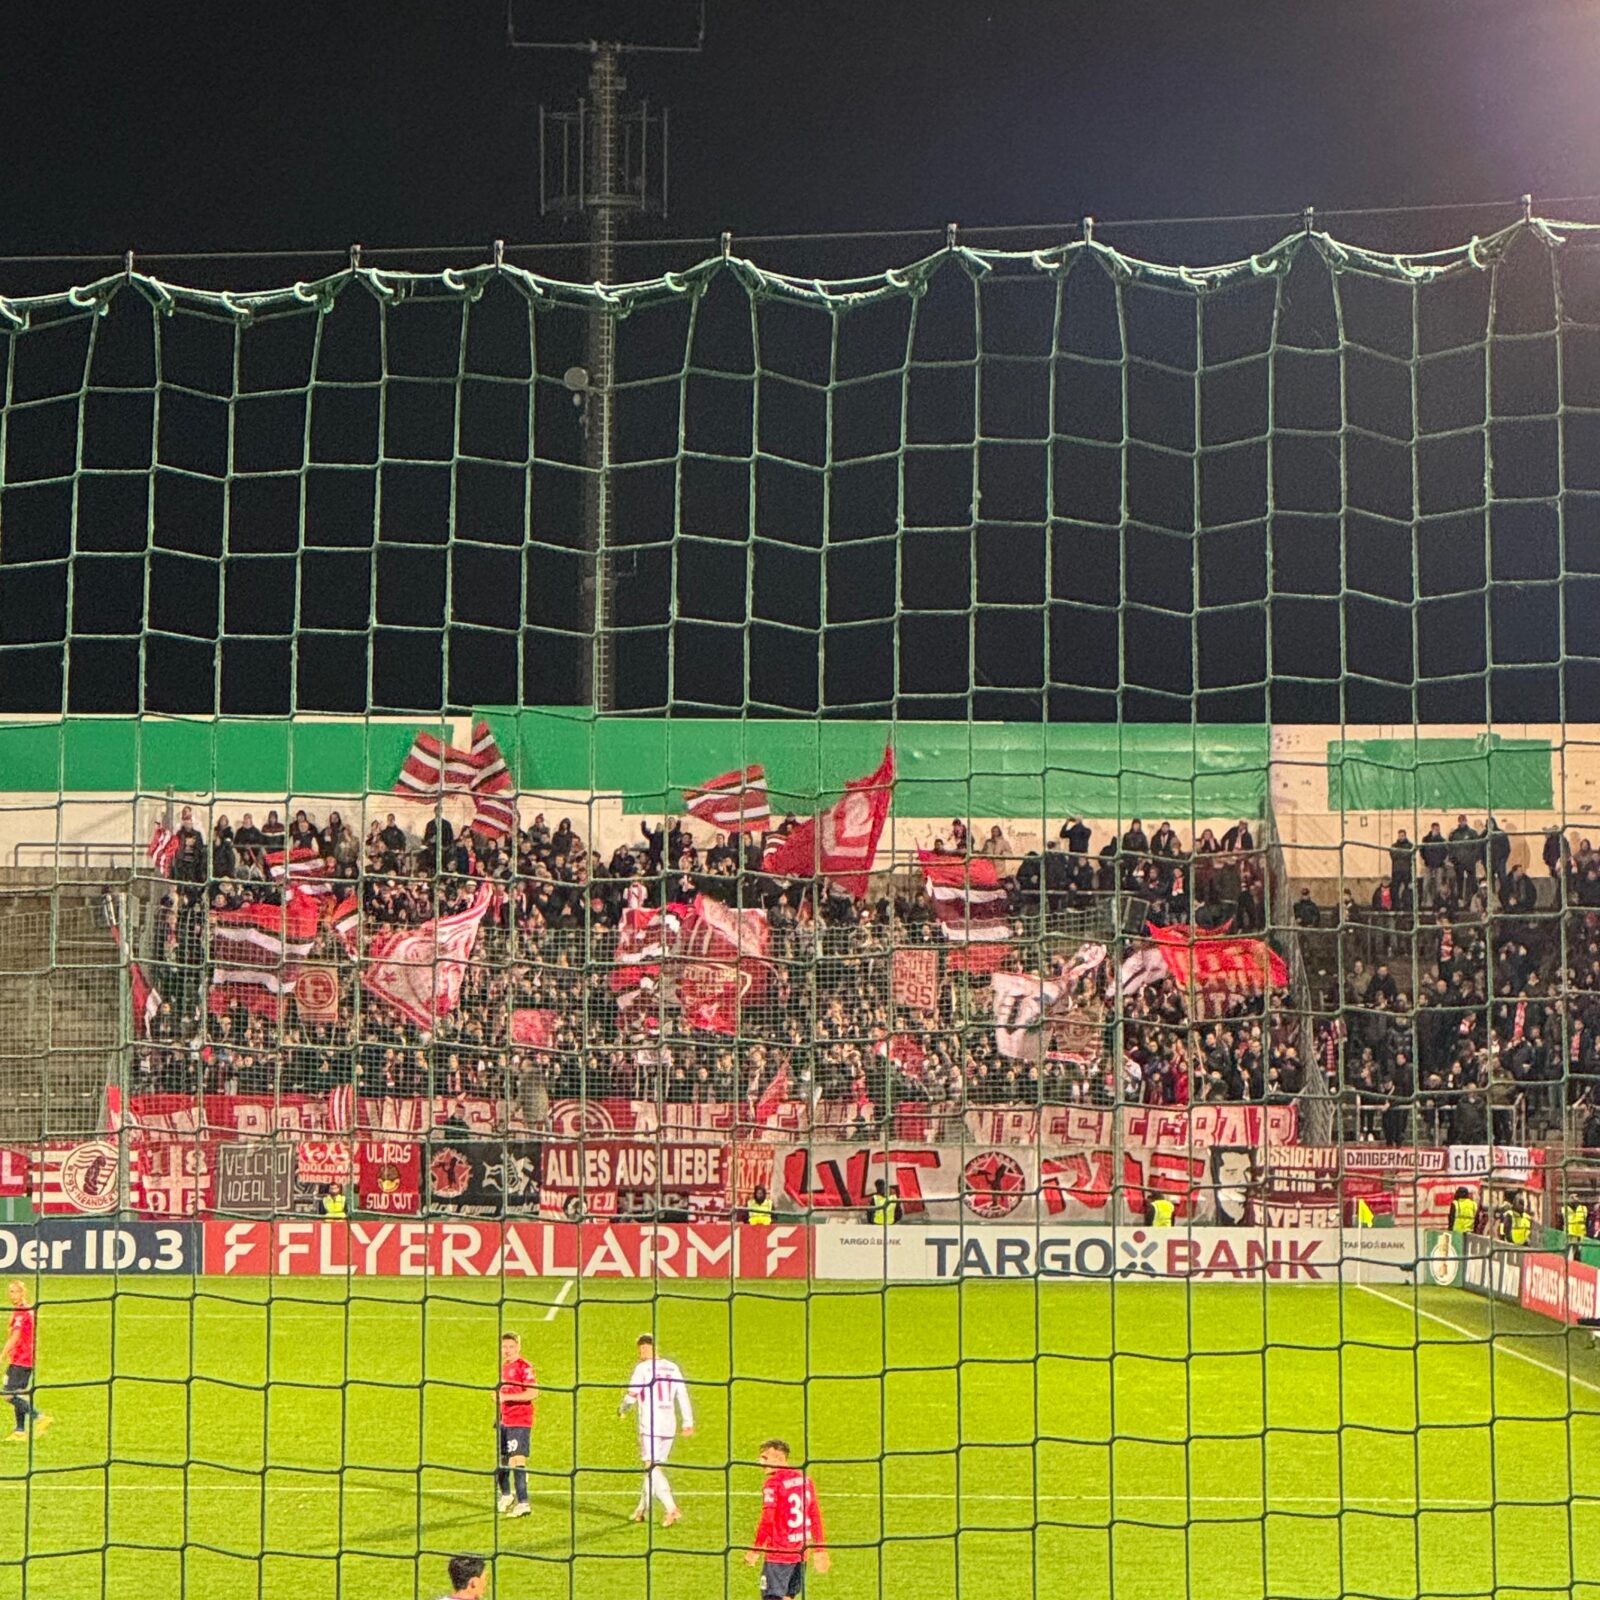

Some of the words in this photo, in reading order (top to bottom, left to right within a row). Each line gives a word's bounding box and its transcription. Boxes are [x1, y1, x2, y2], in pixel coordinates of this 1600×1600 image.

[366, 1143, 412, 1163] ULTRAS
[546, 1148, 611, 1187] ALLES
[615, 1148, 657, 1186] AUS
[661, 1148, 721, 1185] LIEBE
[1273, 1169, 1317, 1193] ULTRA
[85, 1230, 183, 1270] ID.3
[278, 1223, 740, 1276] FLYERALARM
[1567, 1275, 1595, 1319] TRAUSS
